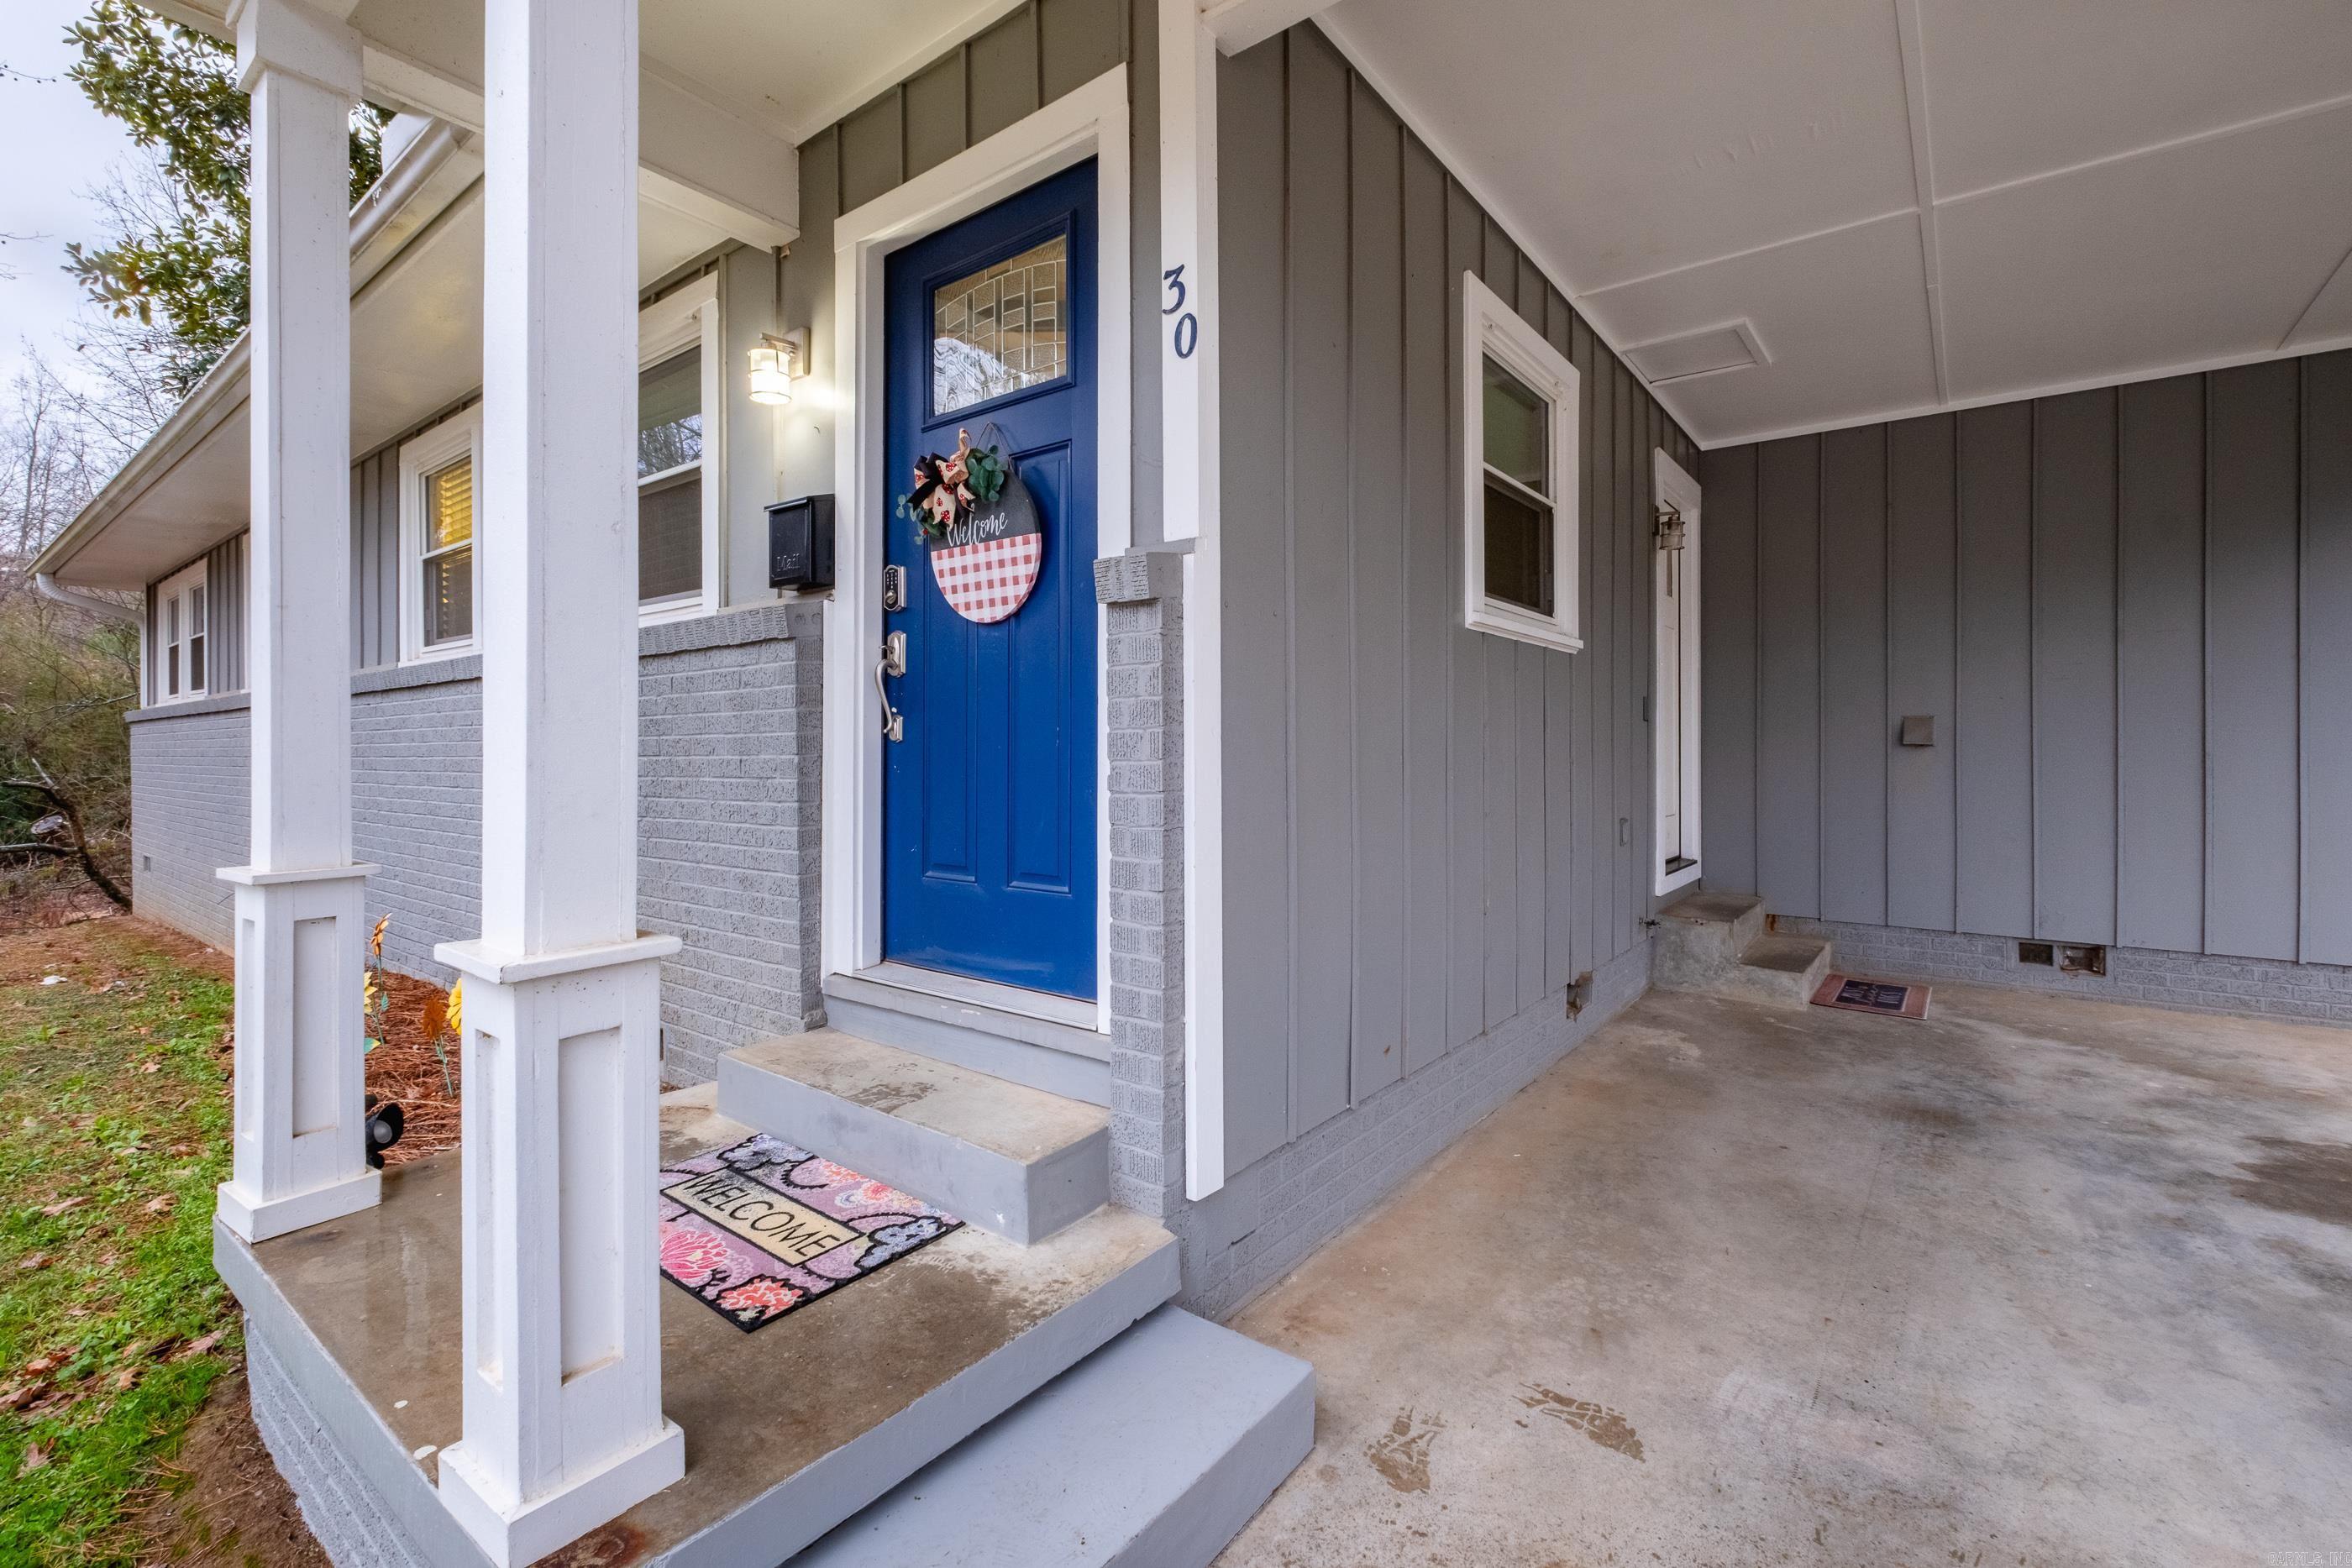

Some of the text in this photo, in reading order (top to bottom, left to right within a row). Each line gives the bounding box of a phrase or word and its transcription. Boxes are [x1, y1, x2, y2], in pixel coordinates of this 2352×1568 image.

[1162, 264, 1198, 359] 30
[947, 504, 1008, 547] Welcome
[683, 1174, 841, 1257] WELCOME
